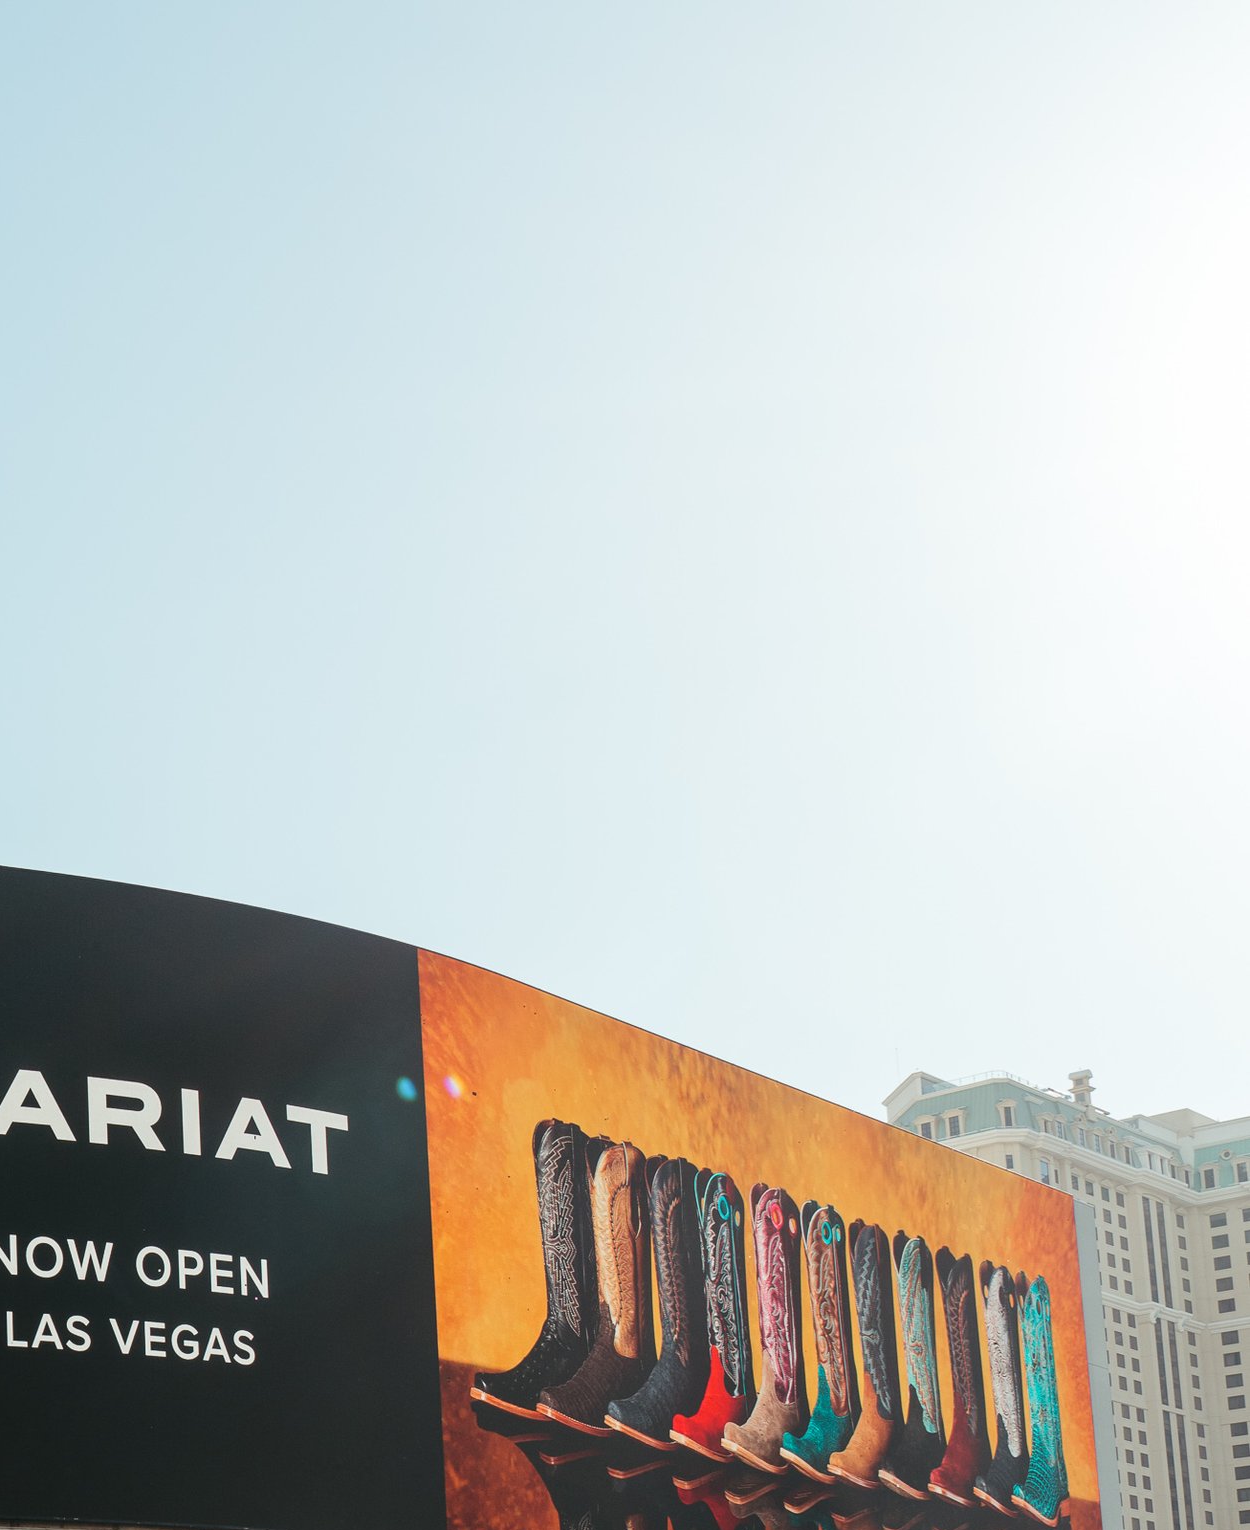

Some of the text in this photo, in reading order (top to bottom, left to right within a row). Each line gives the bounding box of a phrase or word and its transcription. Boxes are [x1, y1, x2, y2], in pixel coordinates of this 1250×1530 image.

[136, 1246, 270, 1299] OPEN
[6, 1311, 257, 1367] LAS VEGAS
